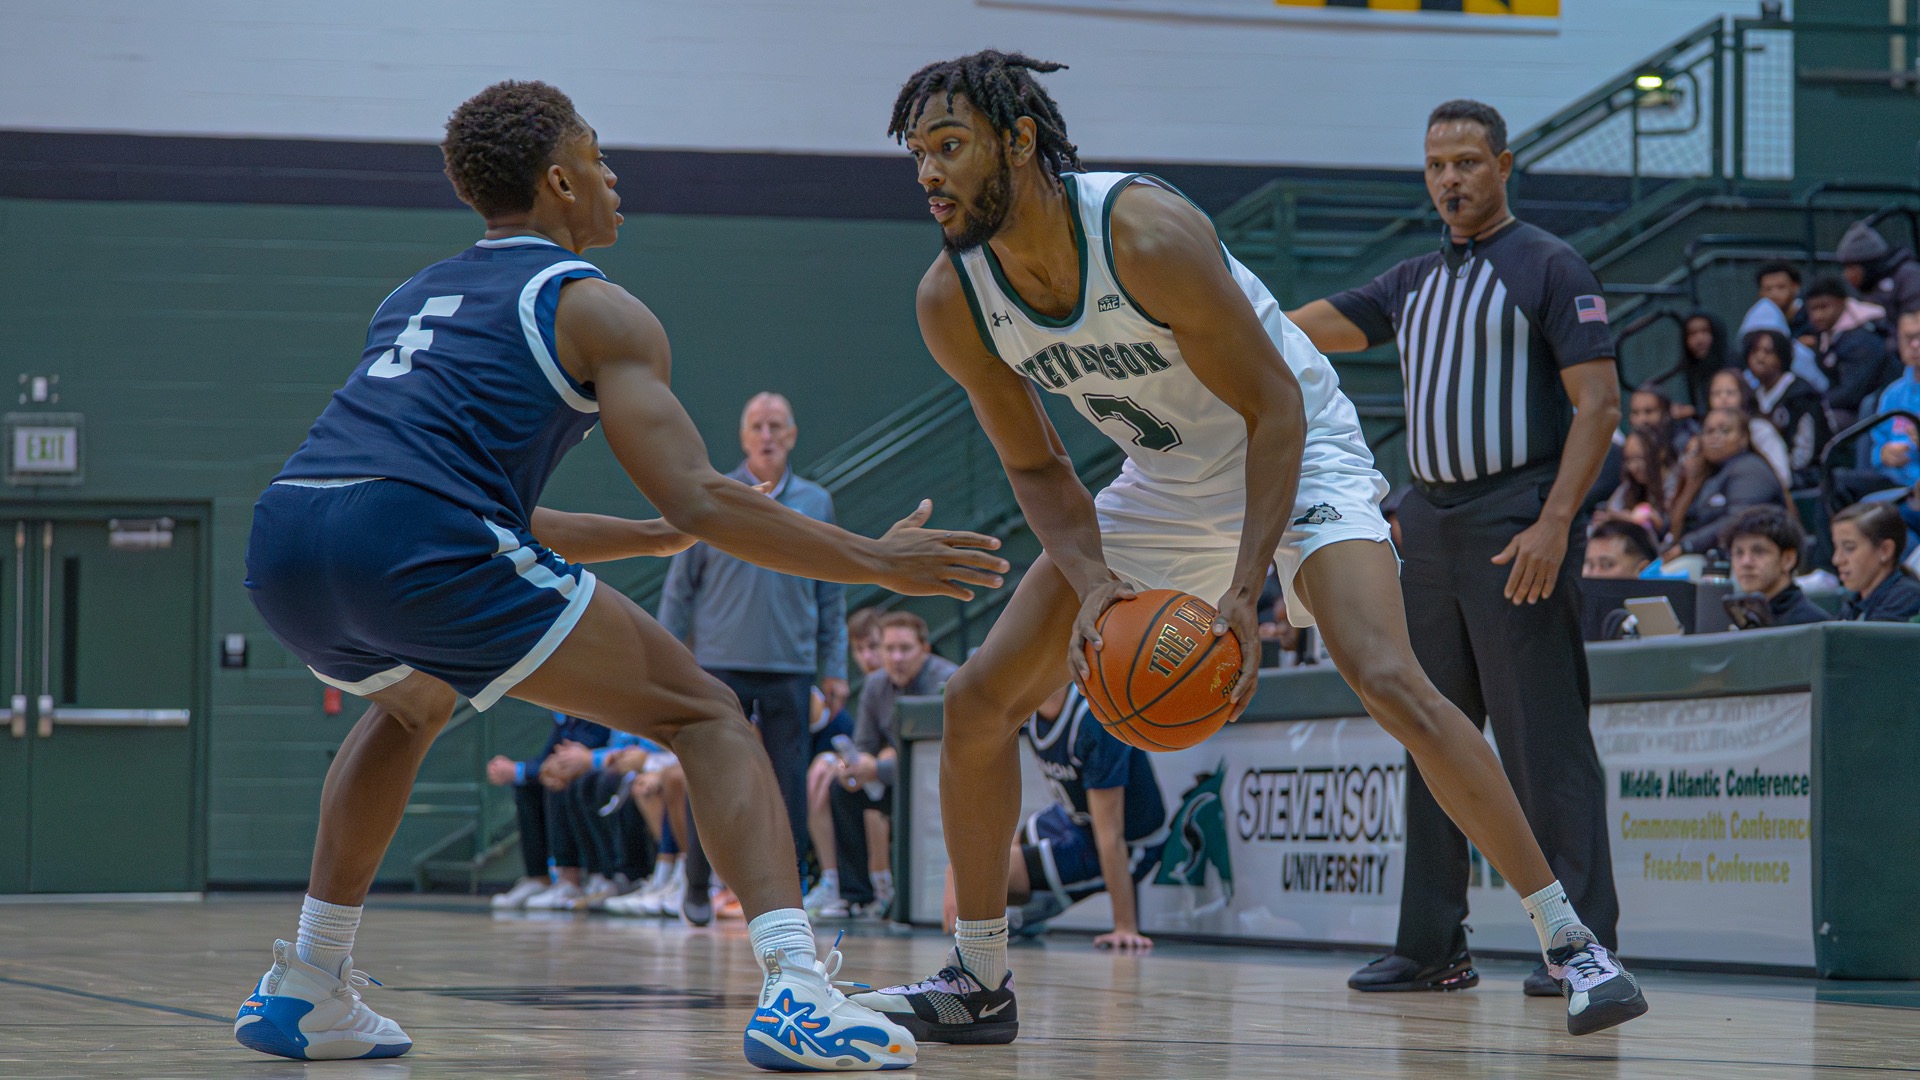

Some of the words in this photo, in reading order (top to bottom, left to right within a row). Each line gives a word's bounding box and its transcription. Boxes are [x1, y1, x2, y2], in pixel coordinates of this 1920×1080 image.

[1099, 301, 1119, 311] MAC
[366, 294, 464, 379] 5
[1082, 392, 1183, 452] 7
[27, 434, 65, 463] EXIT
[1148, 623, 1198, 678] THE
[1619, 770, 1663, 799] Middle
[1667, 768, 1721, 799] Atlantic
[1726, 767, 1810, 798] Conference
[1237, 764, 1406, 842] STEVENSON
[1620, 809, 1727, 841] Commonwealth
[1282, 853, 1389, 895] UNIVERSITY
[1643, 852, 1702, 882] Freedom
[1707, 852, 1791, 884] Conference
